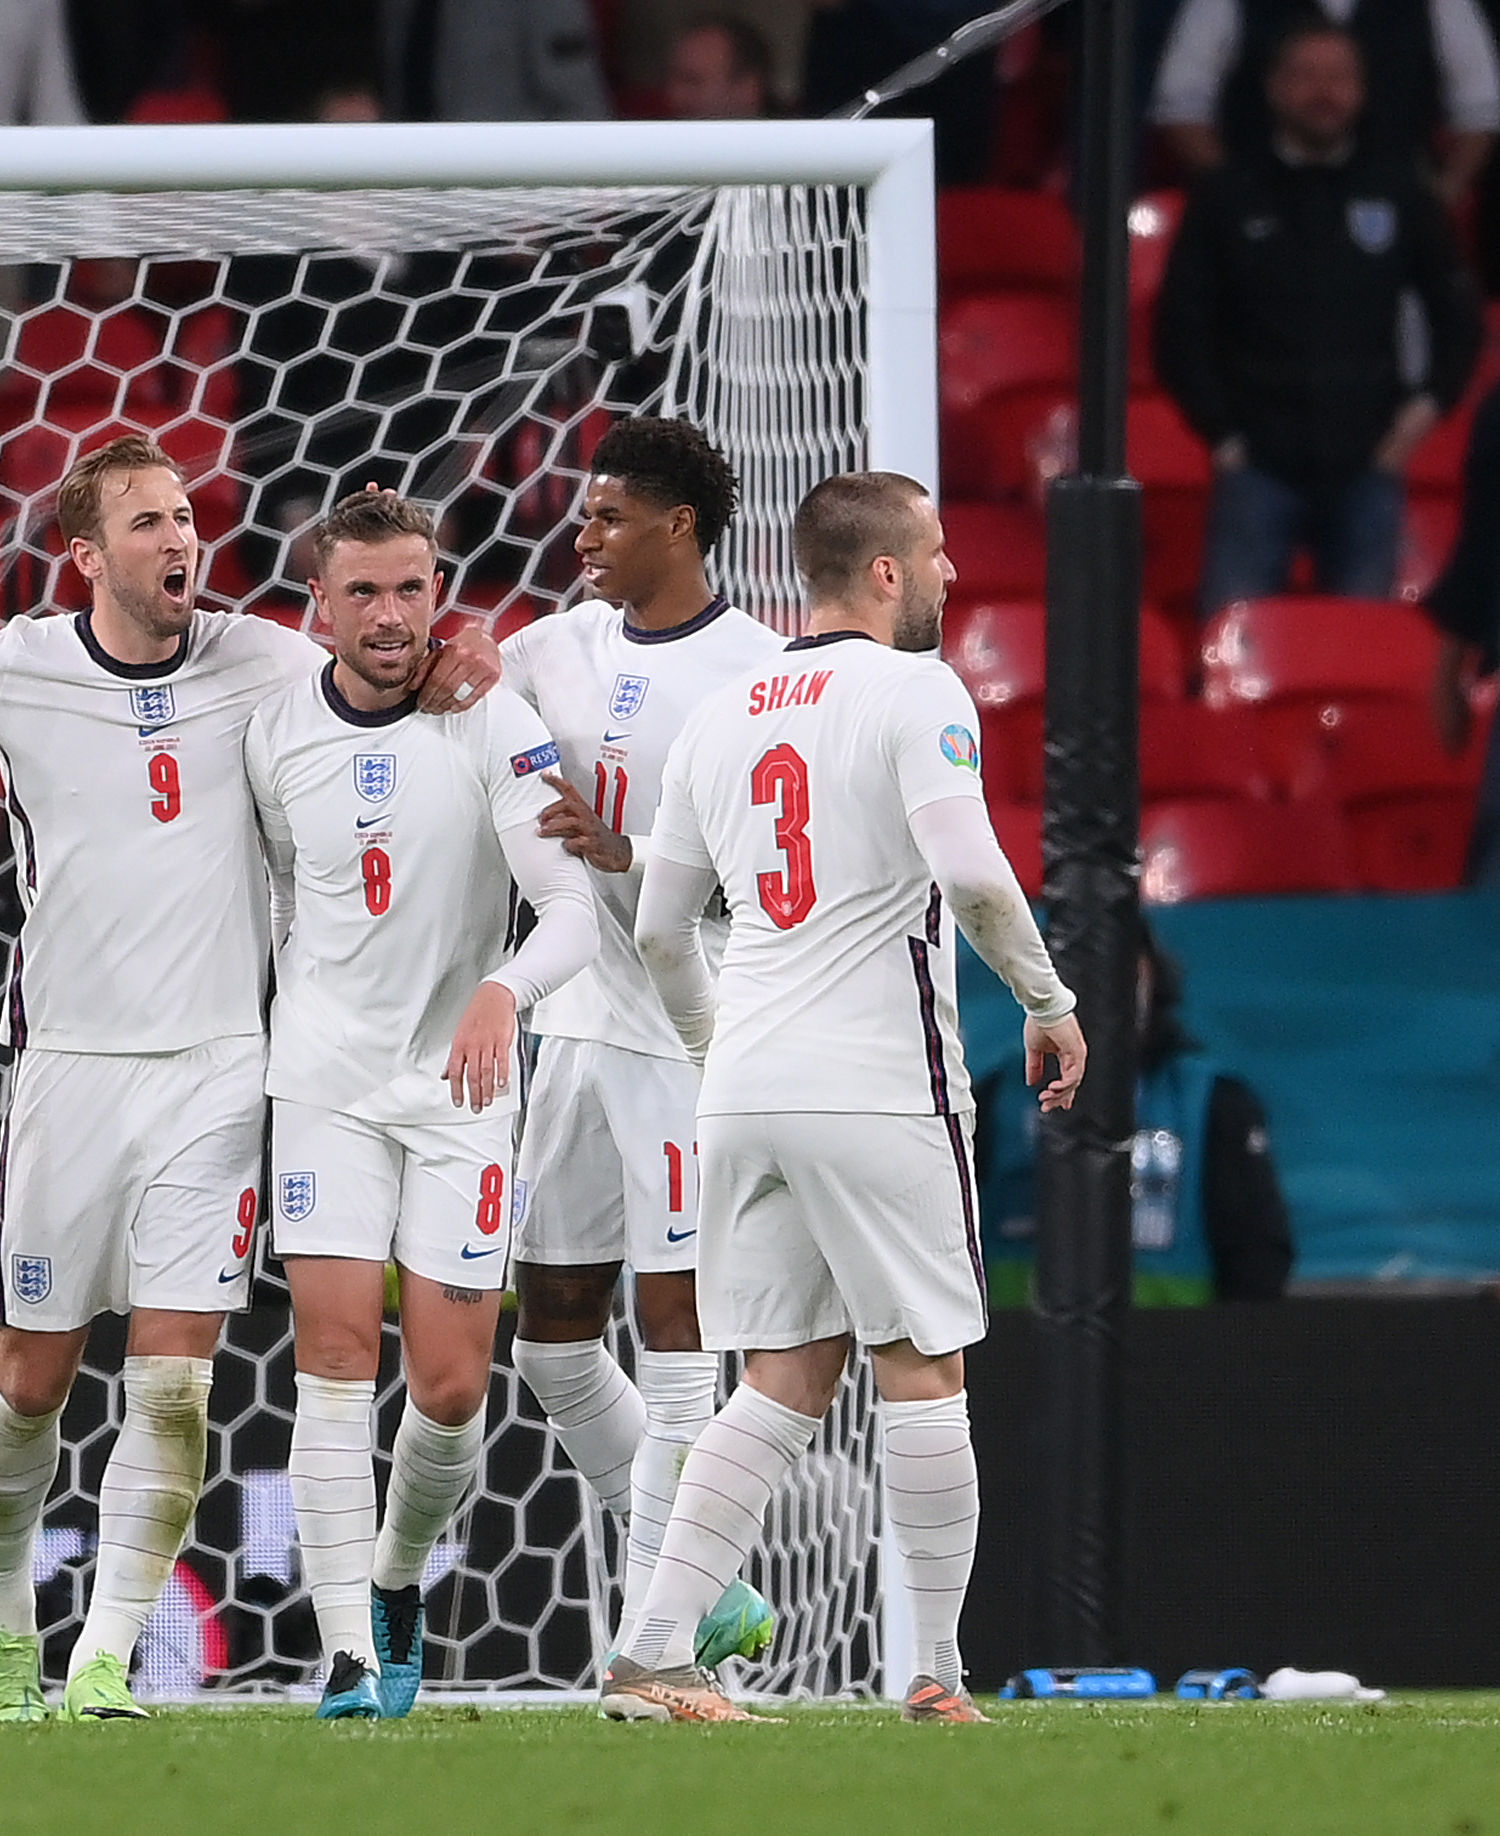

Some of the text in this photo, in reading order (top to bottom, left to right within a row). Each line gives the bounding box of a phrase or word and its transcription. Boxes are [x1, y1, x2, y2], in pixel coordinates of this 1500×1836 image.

[748, 669, 834, 716] SHAW
[147, 752, 181, 823] 9
[594, 760, 628, 835] 11
[750, 742, 817, 930] 3
[361, 846, 391, 917] 8
[476, 1162, 504, 1236] 8
[663, 1140, 699, 1212] 1
[232, 1187, 257, 1259] 9
